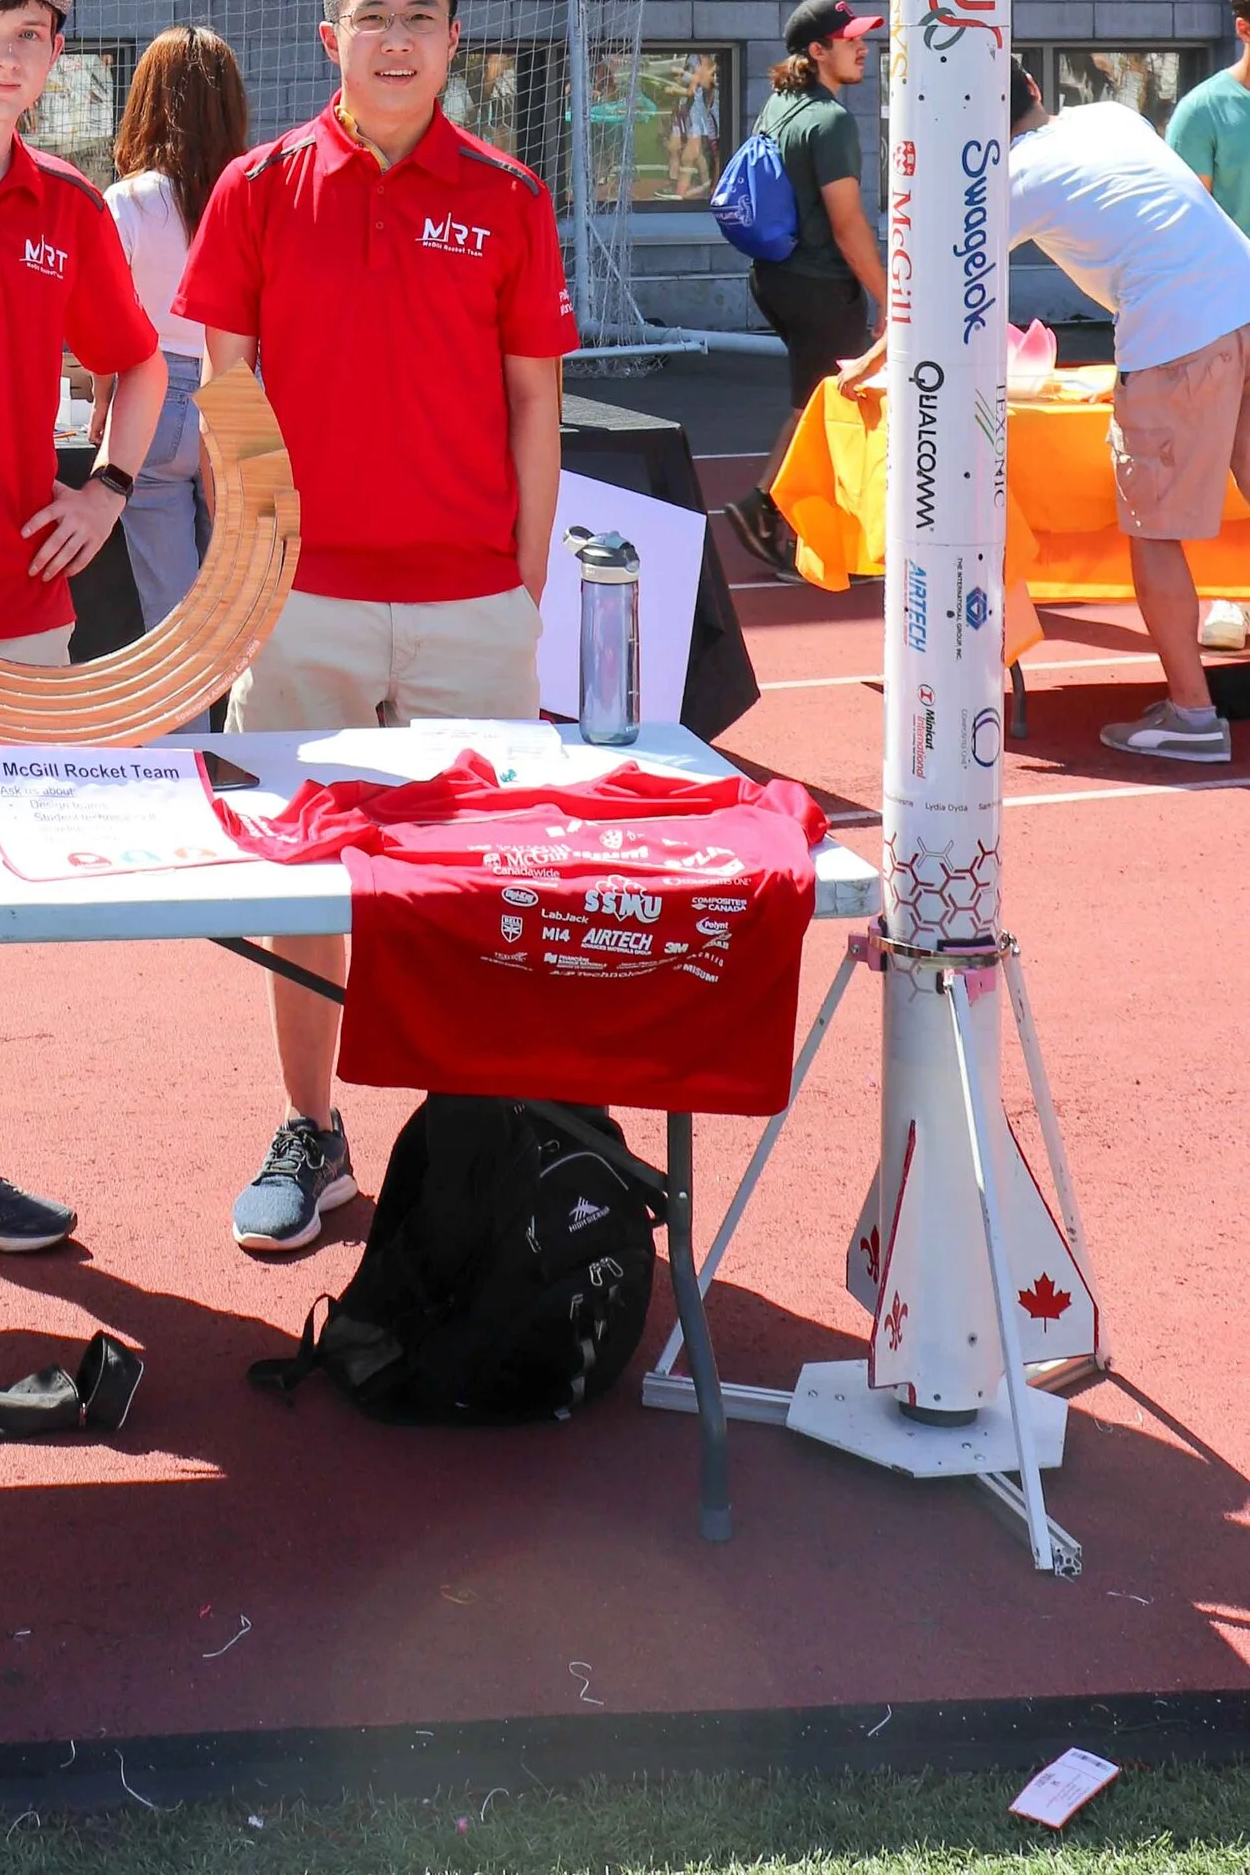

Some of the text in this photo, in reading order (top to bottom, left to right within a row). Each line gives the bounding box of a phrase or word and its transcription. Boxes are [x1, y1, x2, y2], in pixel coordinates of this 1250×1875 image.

[422, 218, 491, 250] MRT
[953, 139, 1001, 345] Swagelok
[25, 238, 69, 273] MRT
[892, 189, 913, 325] McGill
[908, 360, 945, 529] QUALCOMM
[908, 558, 928, 654] AIRTECH
[925, 708, 936, 750] Minicut
[916, 715, 926, 779] International
[2, 761, 180, 779] McGill Rocket Team
[541, 908, 590, 924] LabJack
[584, 889, 663, 923] SSMU
[708, 903, 747, 913] CANADA
[582, 927, 654, 951] AIRTECH
